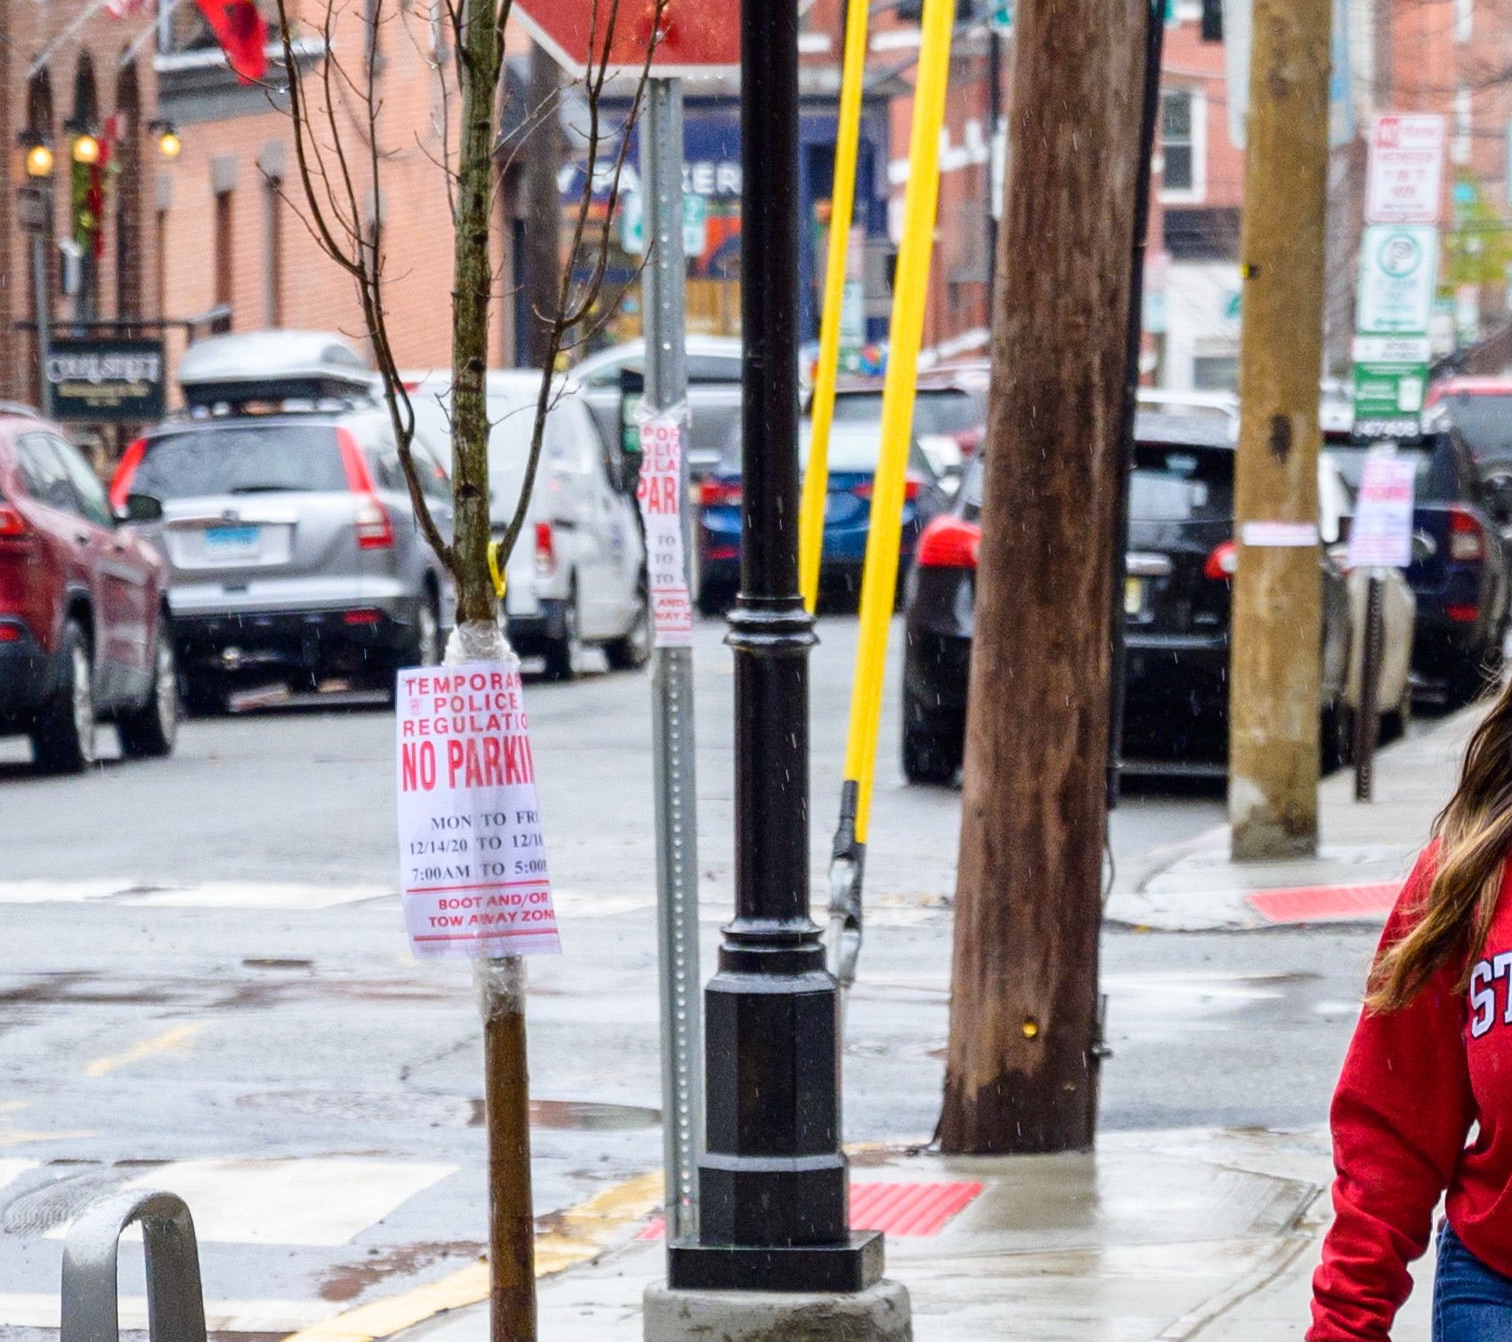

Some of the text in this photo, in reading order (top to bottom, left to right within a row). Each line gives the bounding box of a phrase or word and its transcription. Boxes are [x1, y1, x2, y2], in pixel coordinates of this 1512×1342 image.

[434, 692, 519, 714] POLICE
[402, 740, 436, 792] NO
[431, 815, 472, 831] MON
[481, 812, 506, 827] TO
[409, 839, 468, 855] 12/14/20
[476, 836, 502, 851] TO
[411, 865, 470, 882] 7:00AM
[479, 862, 505, 877] TO
[438, 896, 482, 910] BOOT
[428, 909, 555, 928] TOW AWAY ZON
